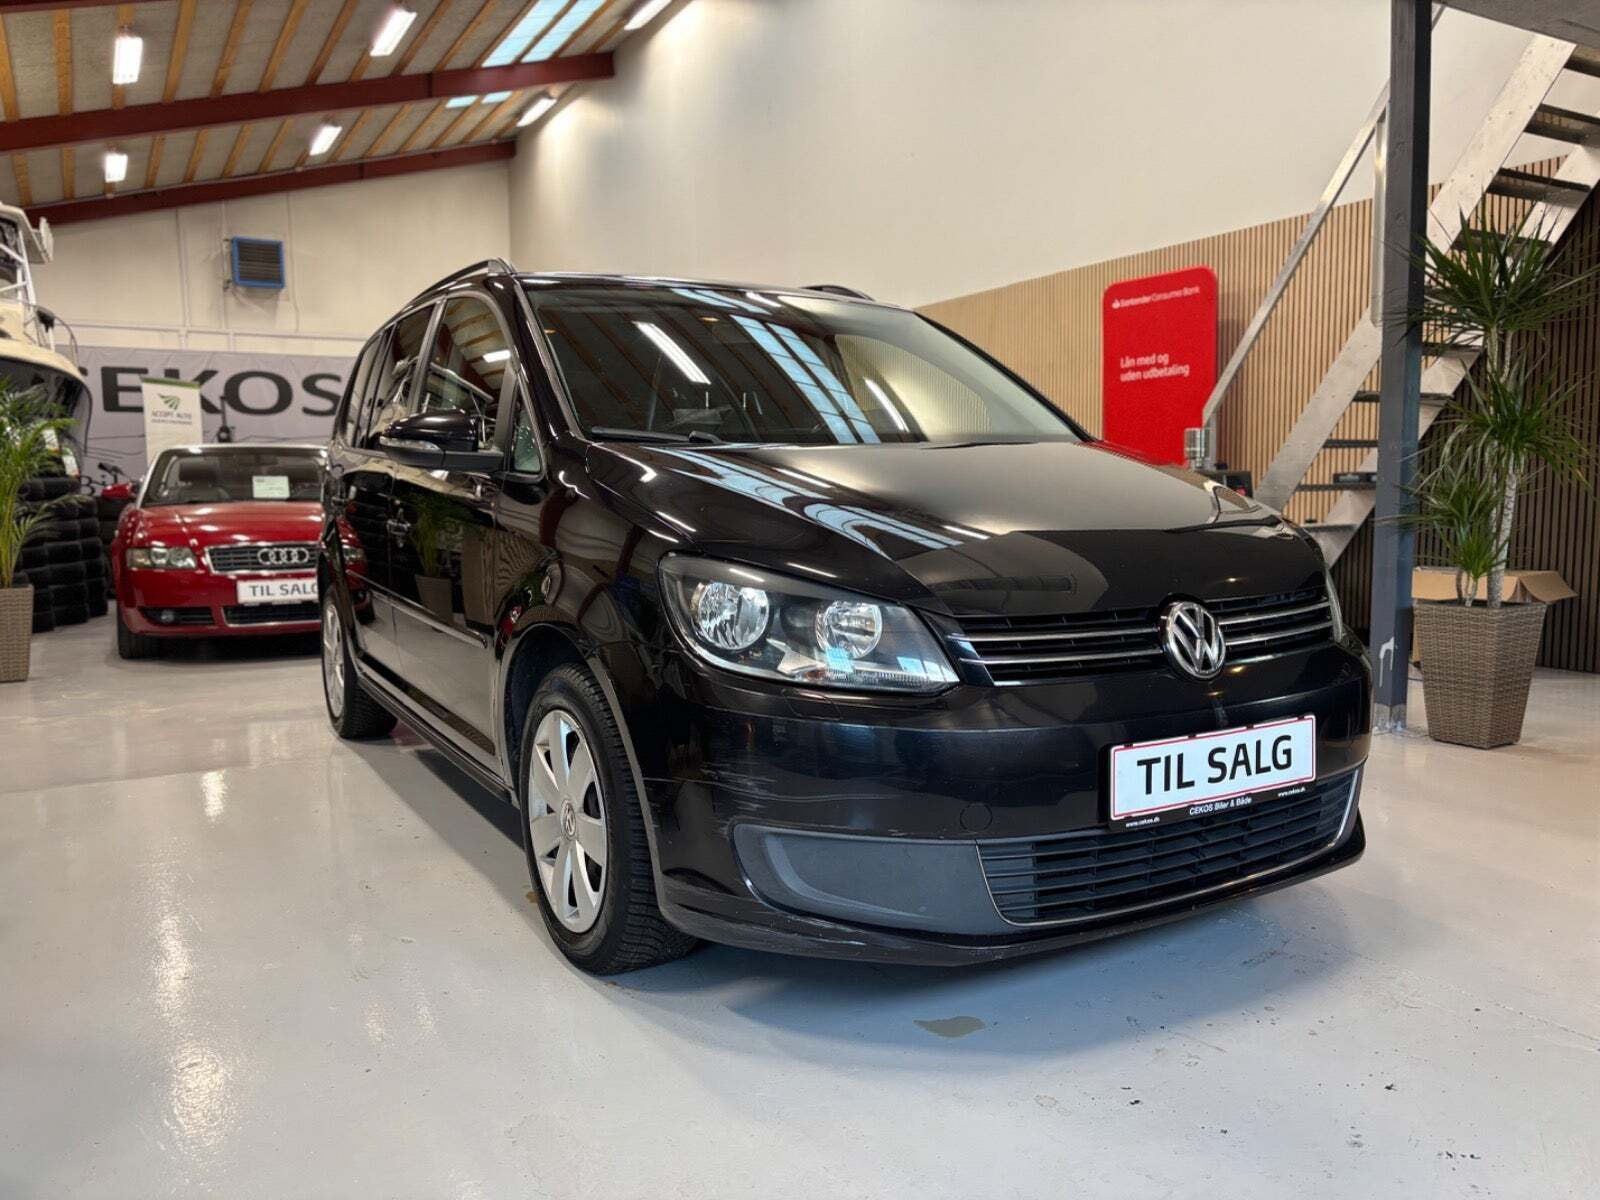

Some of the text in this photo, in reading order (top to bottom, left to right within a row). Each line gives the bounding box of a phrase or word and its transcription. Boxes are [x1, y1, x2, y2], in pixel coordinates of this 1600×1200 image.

[1120, 353, 1169, 369] Lån med og
[1120, 364, 1190, 382] uden udbetaling
[81, 366, 341, 416] EKOS
[249, 584, 275, 597] TIL
[1137, 735, 1292, 795] TIL SALG
[1189, 803, 1214, 816] CEKOS
